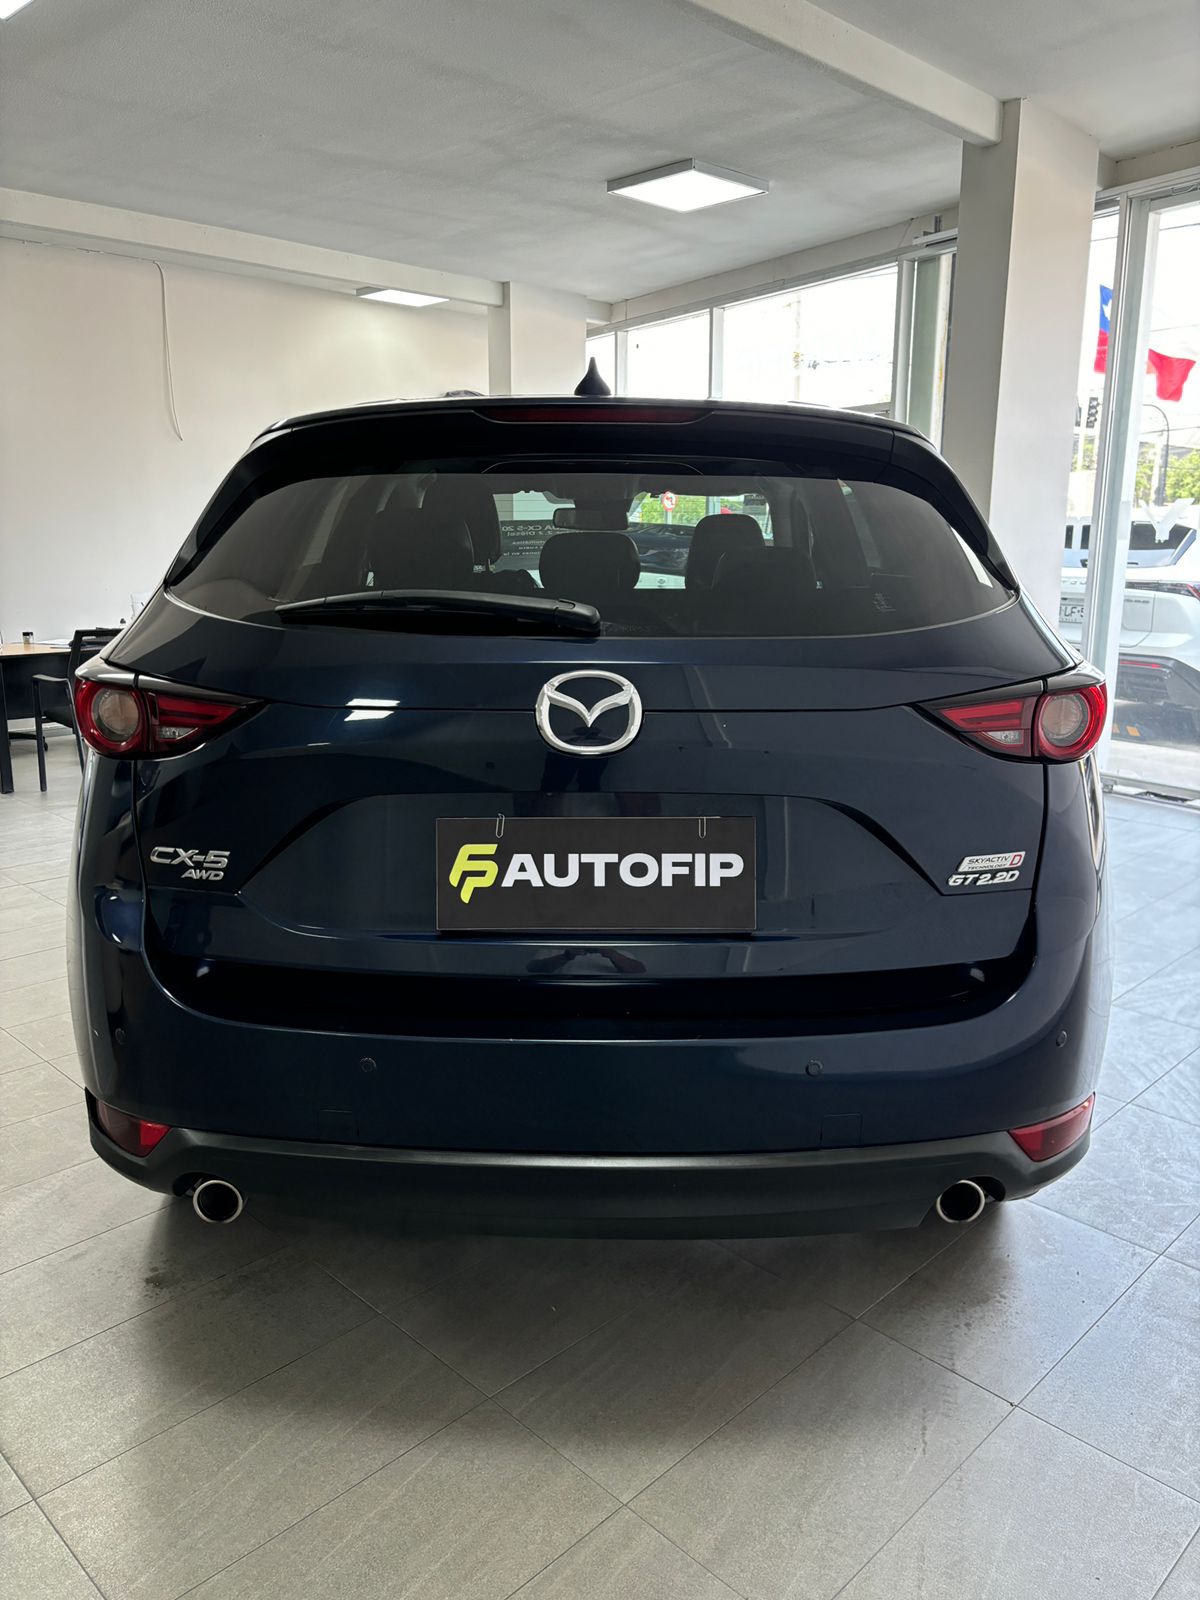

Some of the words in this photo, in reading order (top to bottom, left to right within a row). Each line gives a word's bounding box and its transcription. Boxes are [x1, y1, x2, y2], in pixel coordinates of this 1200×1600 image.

[150, 846, 231, 869] CX-5
[967, 855, 1010, 865] SKYACTIV
[181, 868, 225, 881] AWD
[501, 853, 745, 888] AUTOFIP
